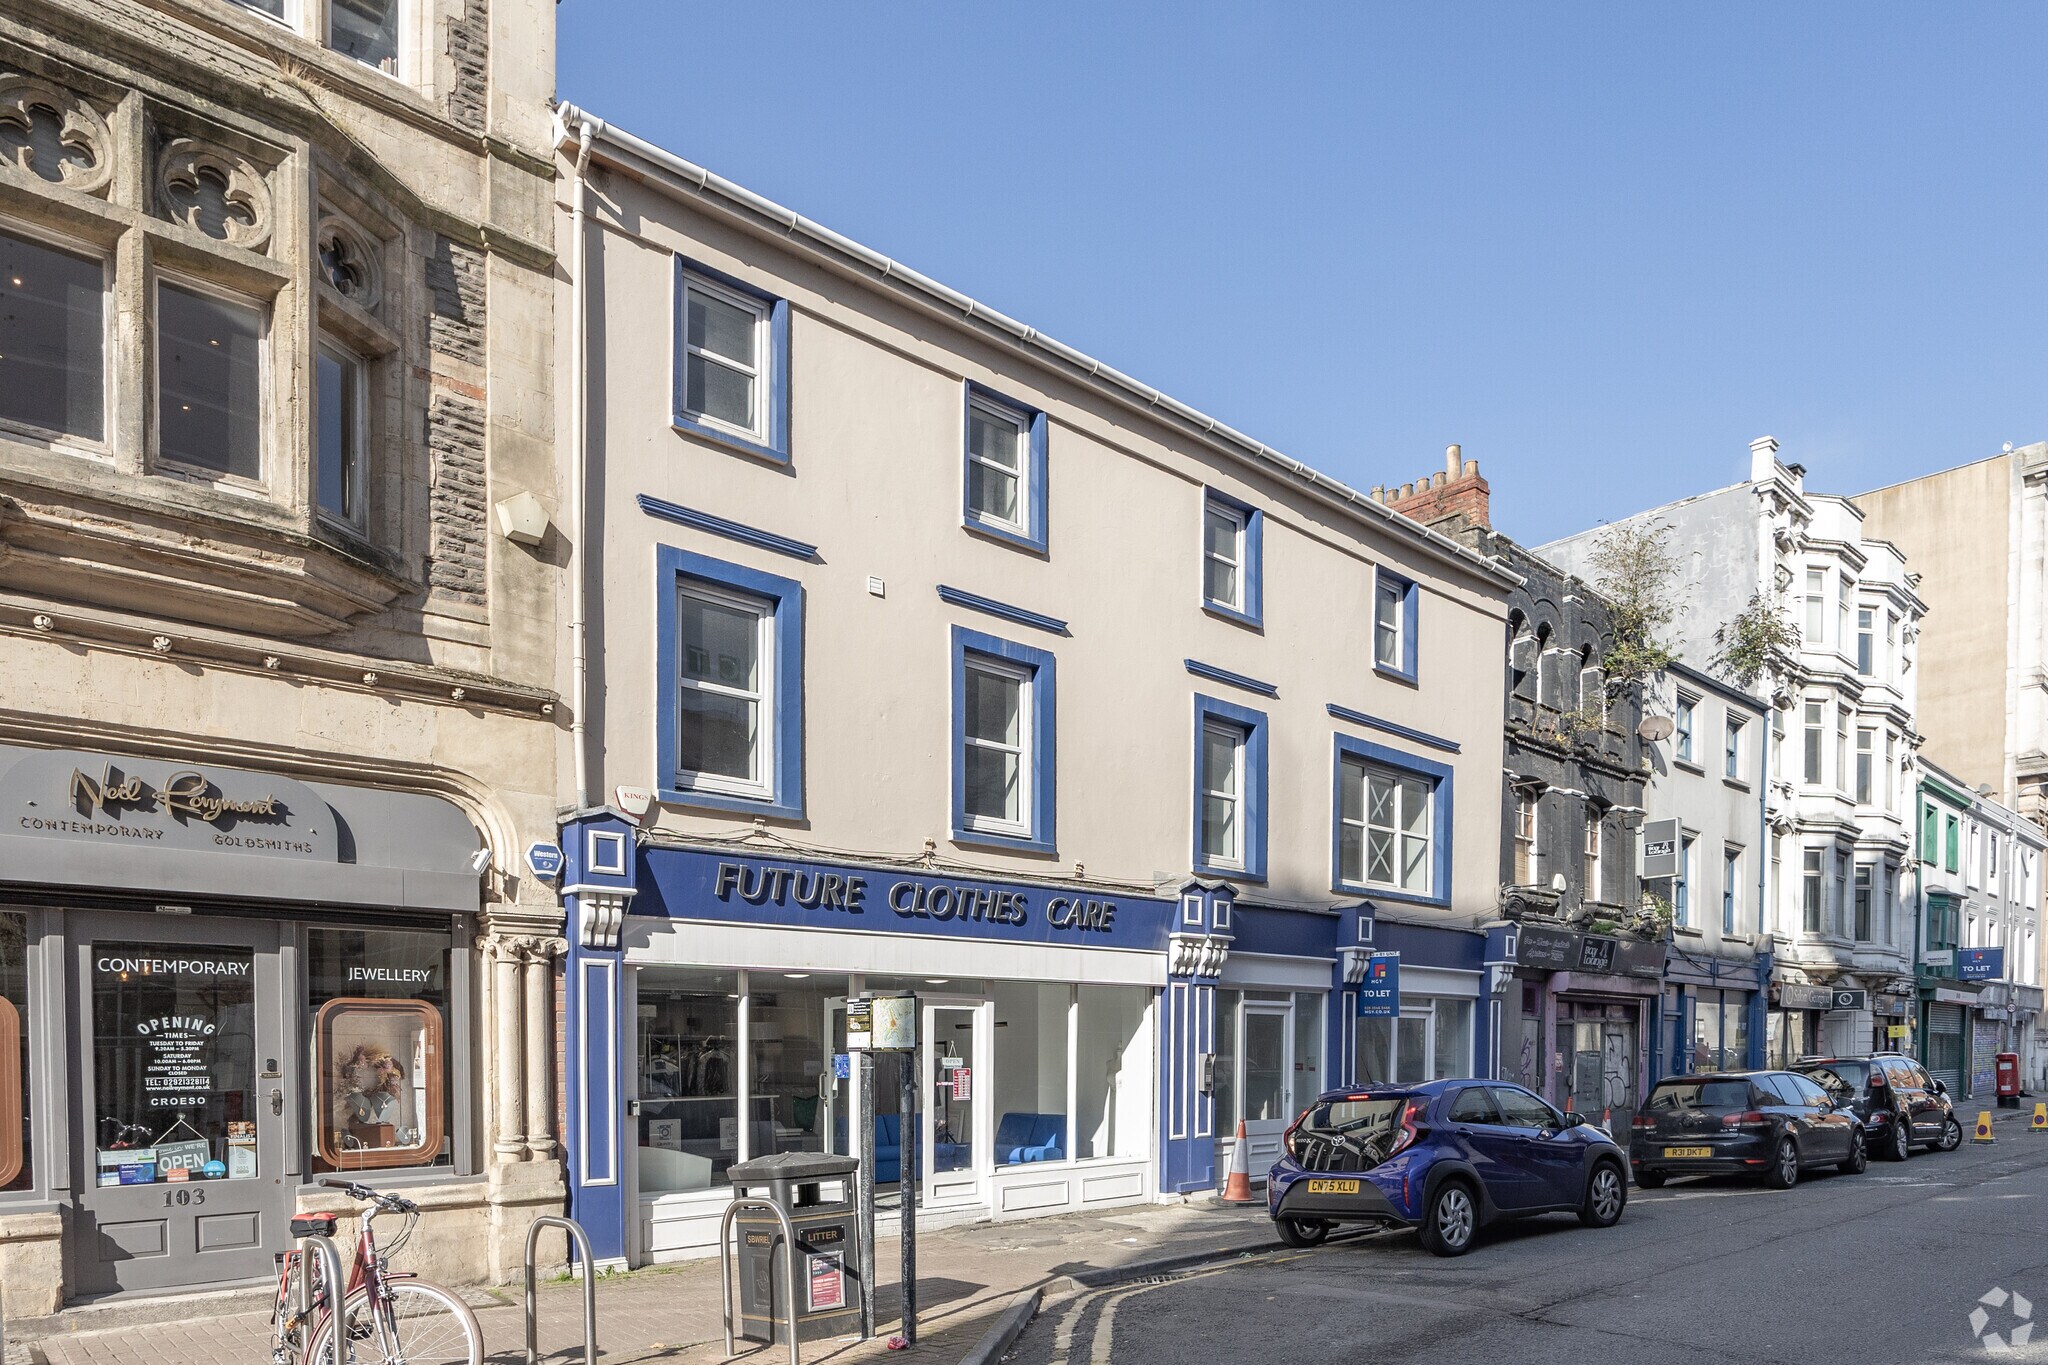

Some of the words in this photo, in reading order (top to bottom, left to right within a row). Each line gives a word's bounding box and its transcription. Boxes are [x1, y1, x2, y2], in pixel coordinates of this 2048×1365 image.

[68, 761, 142, 809] Neil
[624, 792, 649, 801] KINGS
[20, 816, 164, 840] CONTEMPORARY
[213, 834, 313, 854] GOLDSMITHS
[533, 850, 558, 859] Western
[714, 862, 865, 909] FUTURE
[887, 881, 1028, 923] CLOTHES
[1045, 896, 1116, 930] CARE
[97, 957, 250, 976] CONTEMPORARY
[348, 967, 430, 982] JEWELLERY
[1364, 990, 1375, 998] TO
[137, 1016, 216, 1036] OPENING
[150, 1096, 206, 1106] CROESO
[184, 1142, 206, 1150] WE'RE
[1672, 1148, 1685, 1156] R31
[1686, 1148, 1703, 1156] DKT
[159, 1153, 205, 1172] OPEN
[1312, 1181, 1335, 1191] CN75
[1336, 1181, 1356, 1192] XLU
[162, 1187, 206, 1208] 103
[747, 1235, 770, 1244] SBWRIEL
[807, 1230, 838, 1242] LITTER
